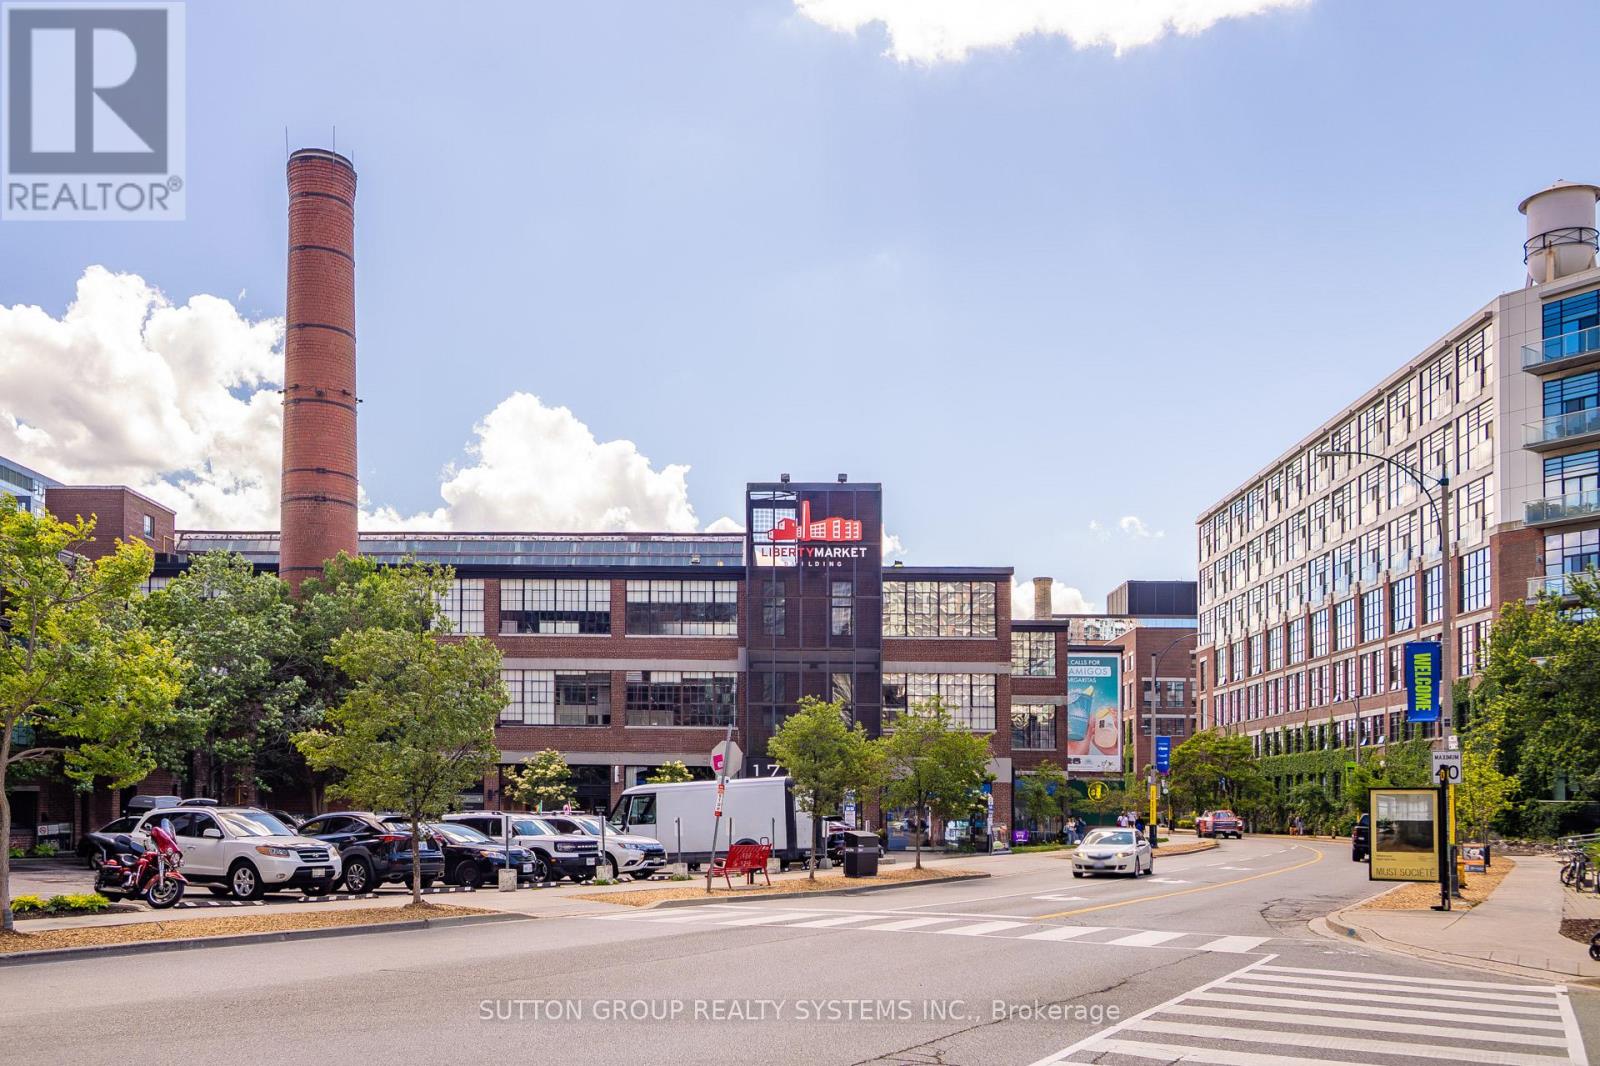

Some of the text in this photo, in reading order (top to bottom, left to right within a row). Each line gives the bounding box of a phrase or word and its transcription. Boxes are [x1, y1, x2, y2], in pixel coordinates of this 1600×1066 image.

[1069, 667, 1108, 676] AMIGOS
[1413, 652, 1432, 711] WELCOME
[1376, 867, 1397, 876] MUST
